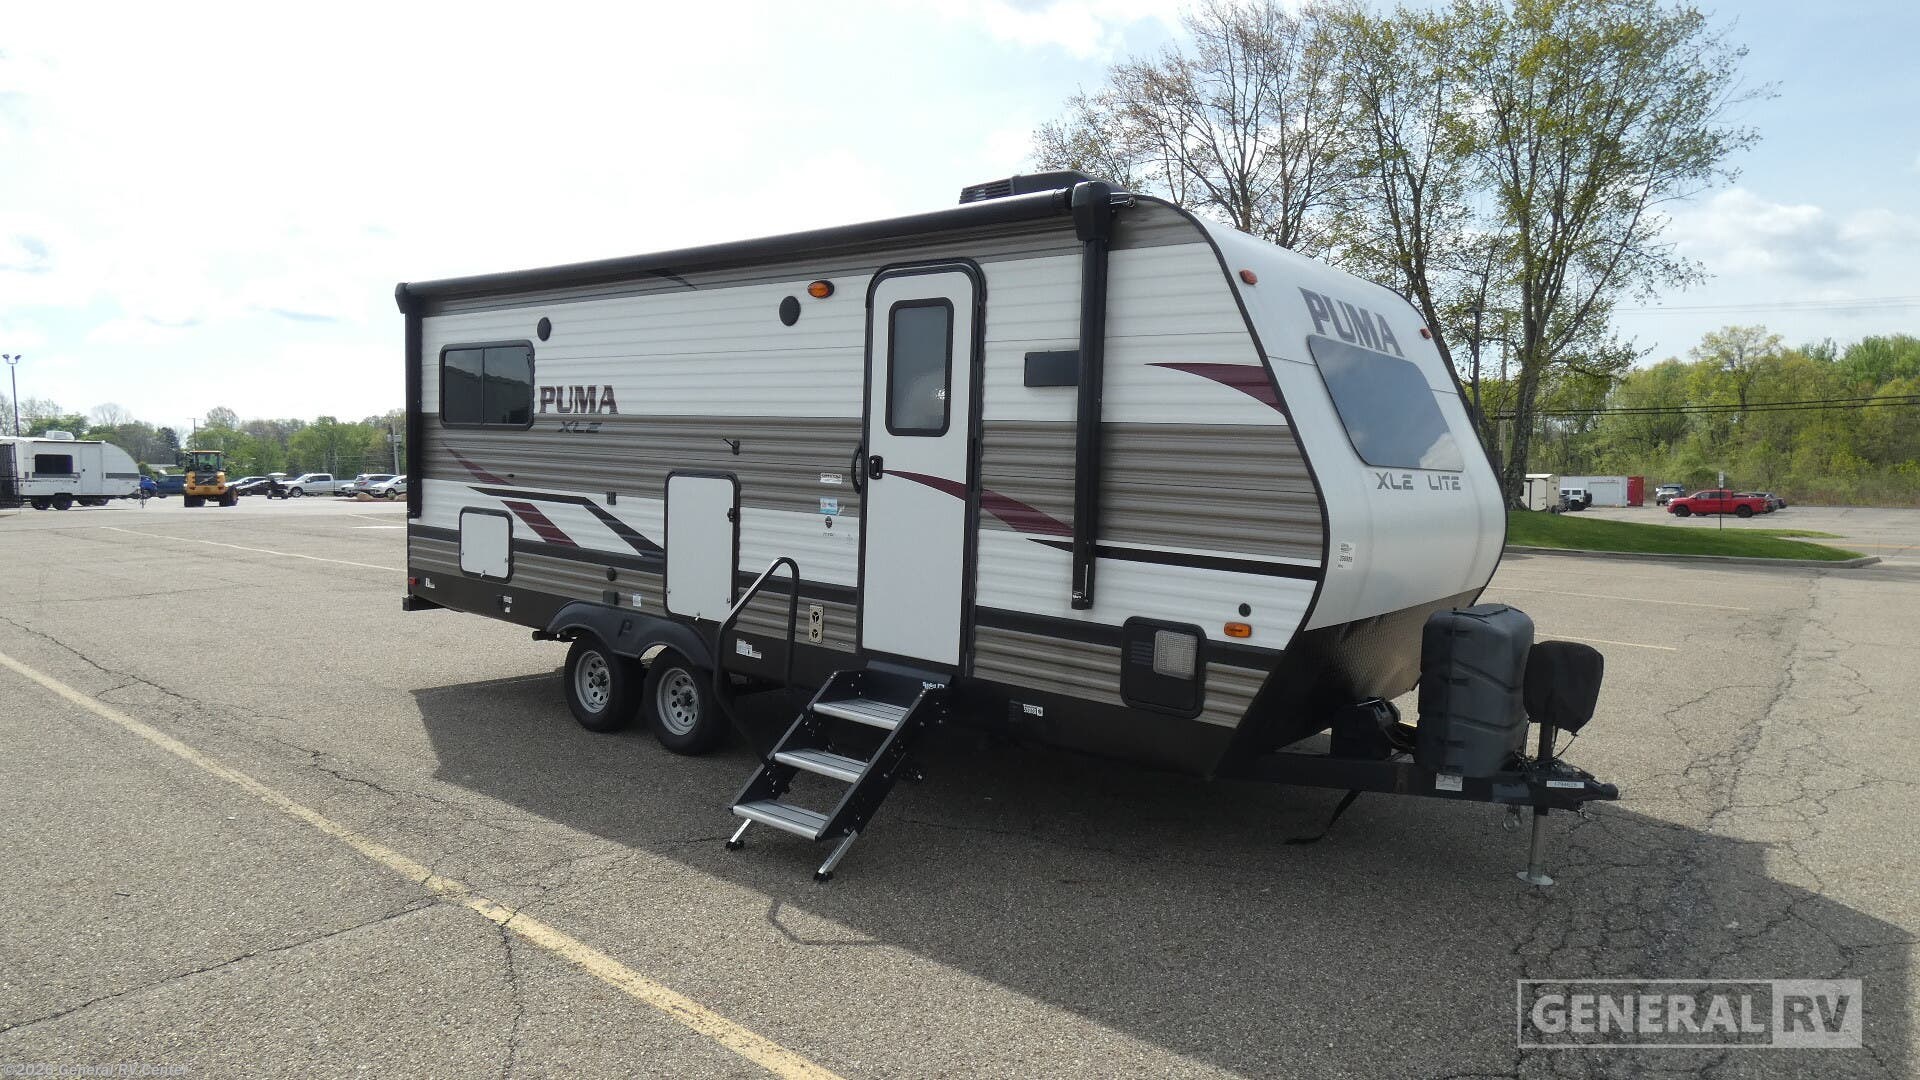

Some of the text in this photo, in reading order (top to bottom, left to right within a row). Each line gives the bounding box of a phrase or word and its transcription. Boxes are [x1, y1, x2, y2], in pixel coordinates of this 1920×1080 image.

[1298, 286, 1404, 357] PUMA
[539, 385, 619, 414] PUMA
[558, 420, 602, 433] XLE
[1376, 472, 1461, 490] XLE LITE
